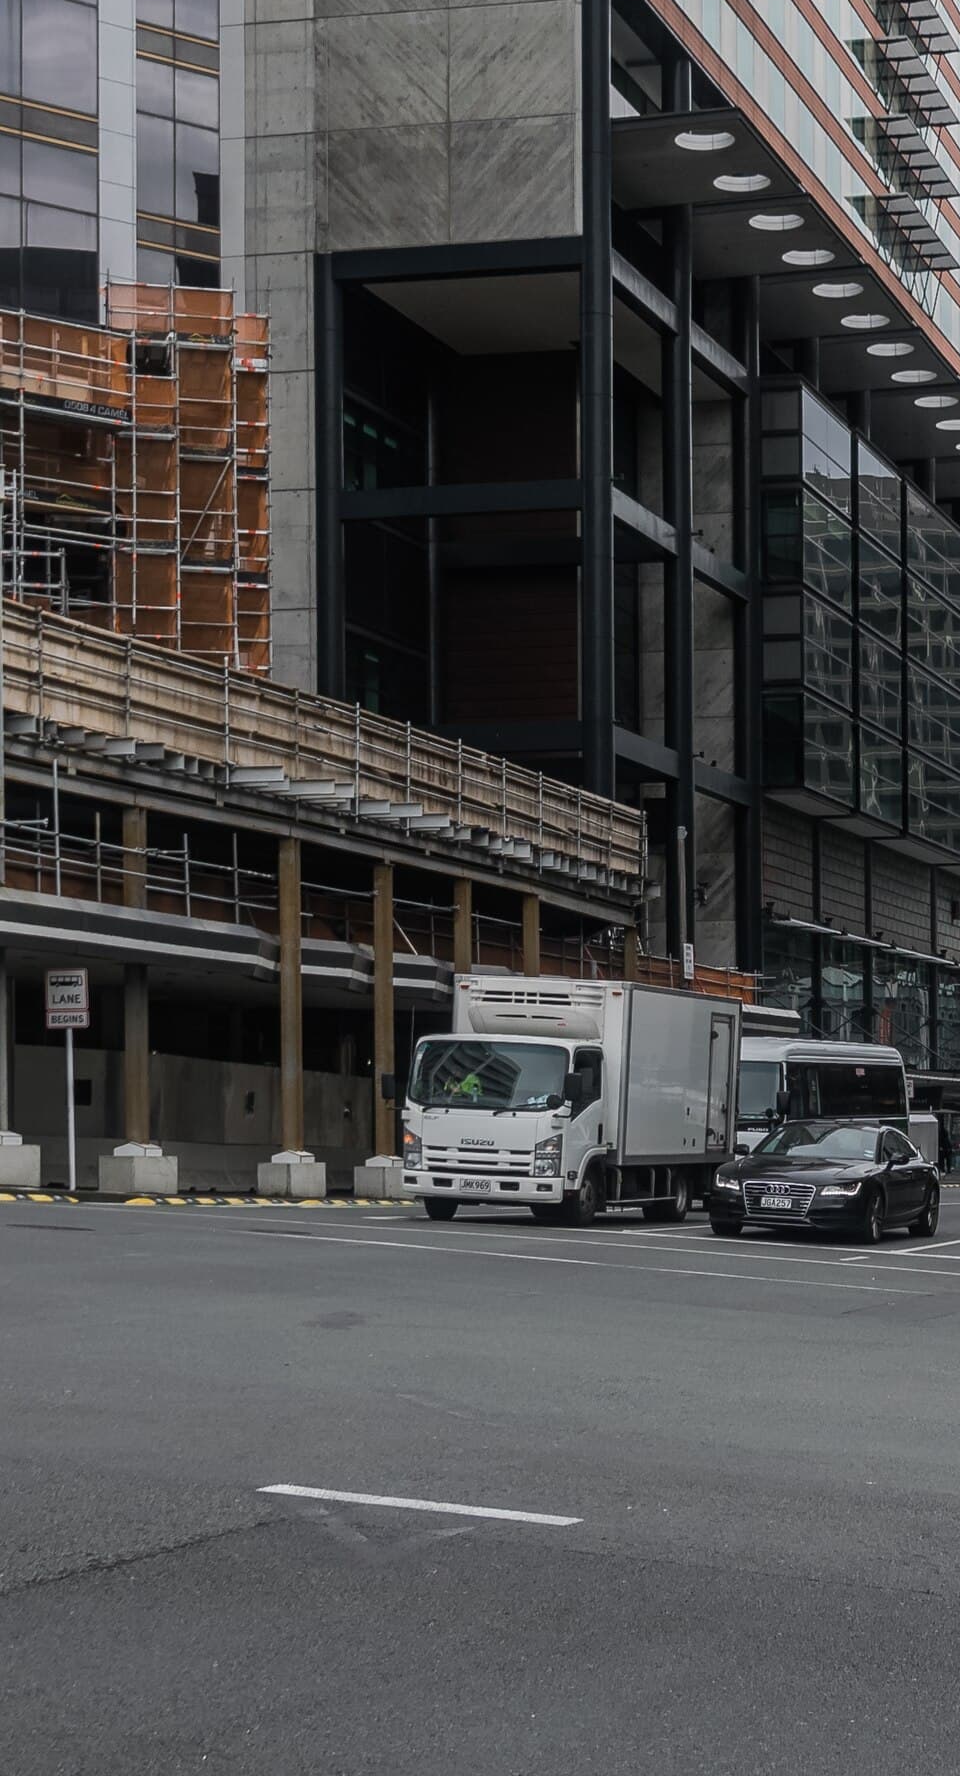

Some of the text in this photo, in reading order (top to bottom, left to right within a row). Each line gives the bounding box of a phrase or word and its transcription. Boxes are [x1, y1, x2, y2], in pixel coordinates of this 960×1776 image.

[98, 406, 129, 420] CAMEL
[52, 993, 81, 1004] LANE
[51, 1014, 85, 1024] BEGINS
[460, 1138, 495, 1146] ISUZU
[462, 1179, 490, 1190] JMK969
[762, 1198, 791, 1208] JGA257
